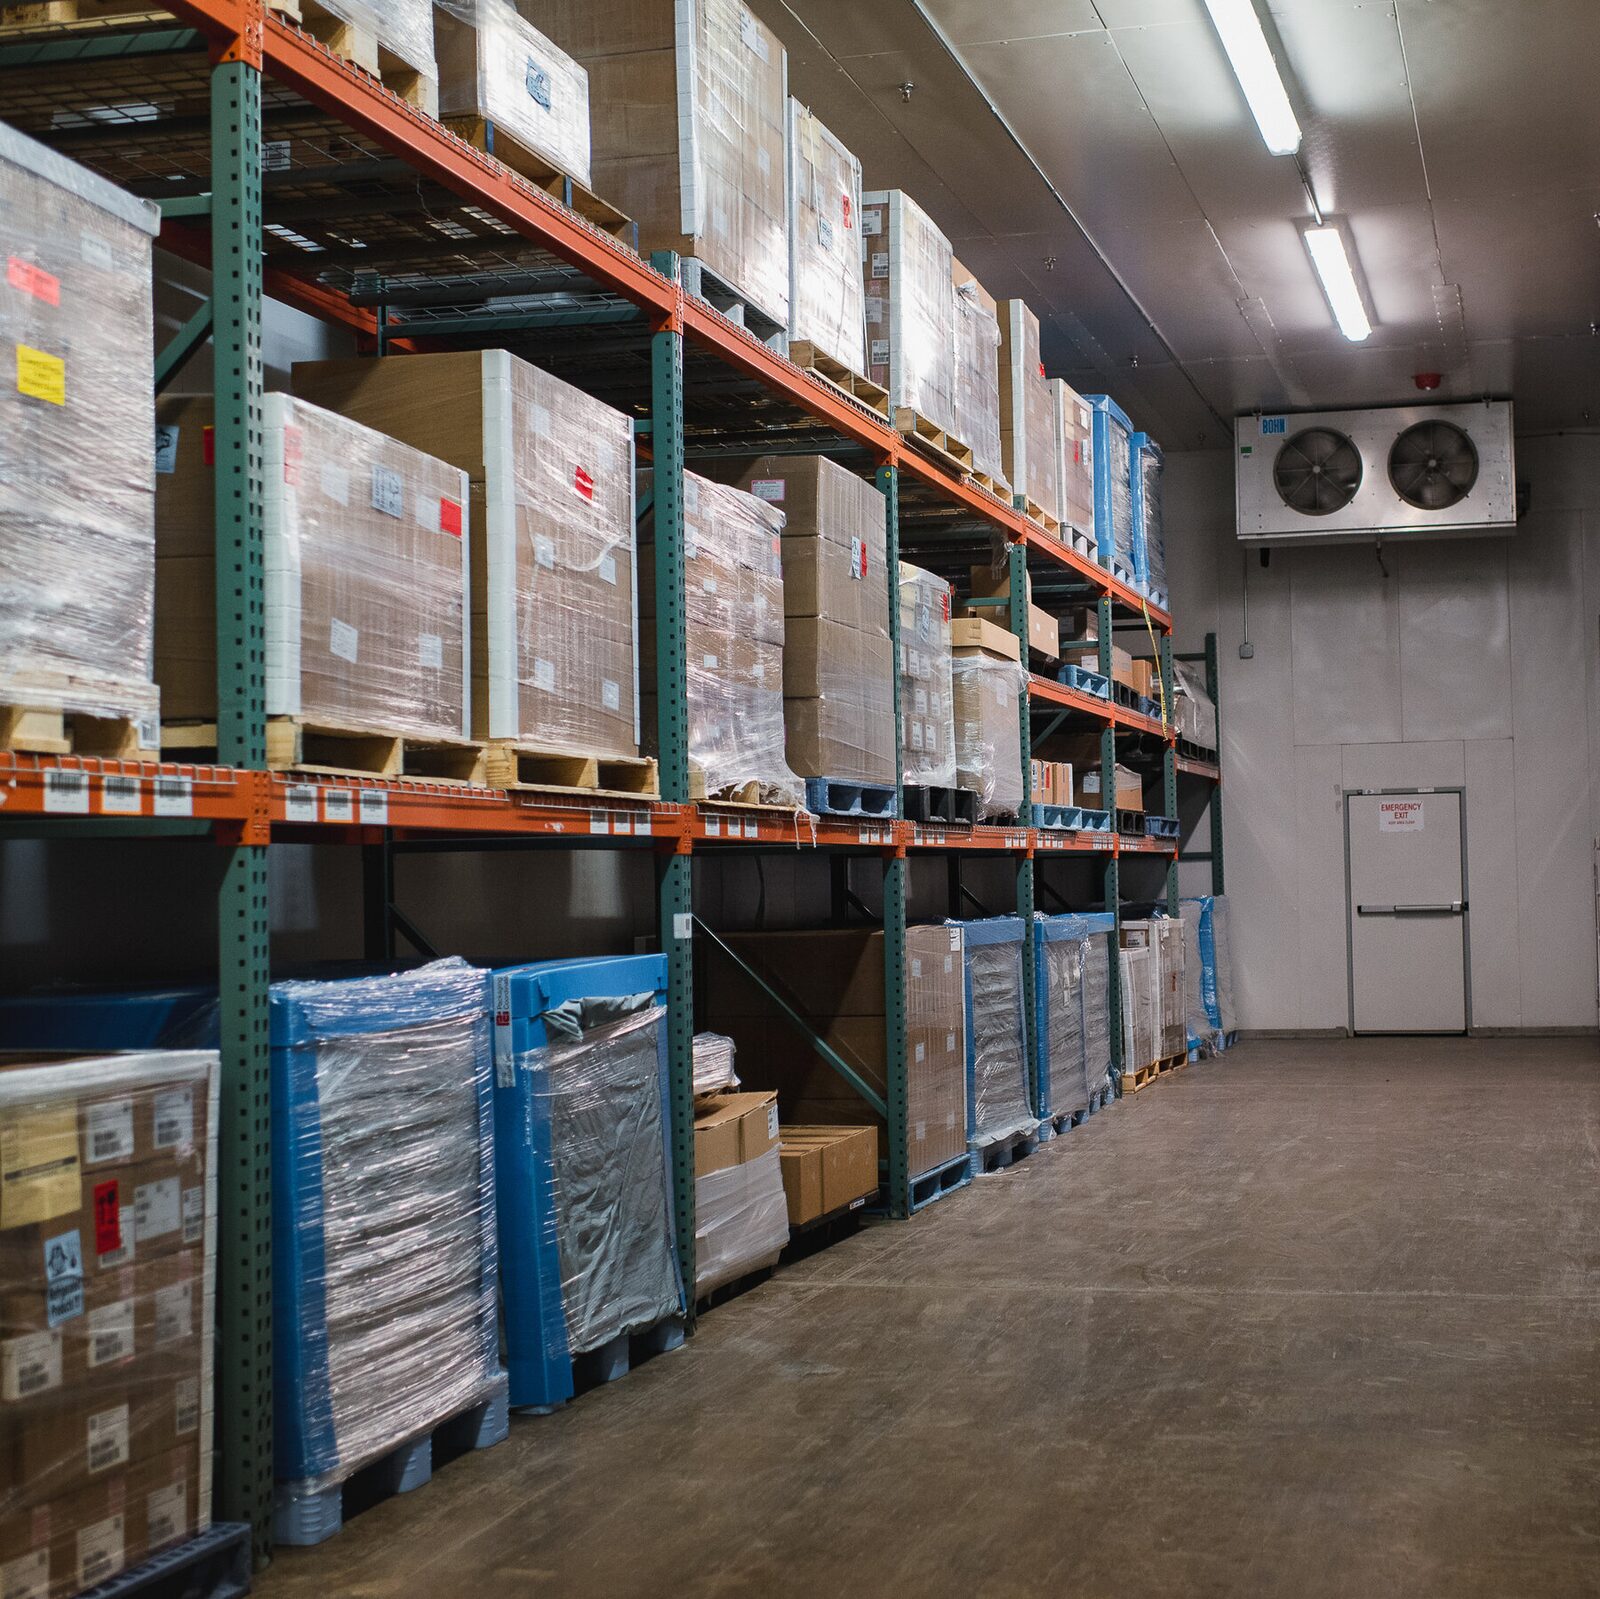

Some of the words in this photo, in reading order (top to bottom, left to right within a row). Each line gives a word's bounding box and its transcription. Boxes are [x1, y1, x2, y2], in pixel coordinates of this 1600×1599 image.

[1263, 418, 1285, 434] BOHN
[1381, 803, 1421, 811] EMERGENCY
[1394, 811, 1408, 819] EXIT
